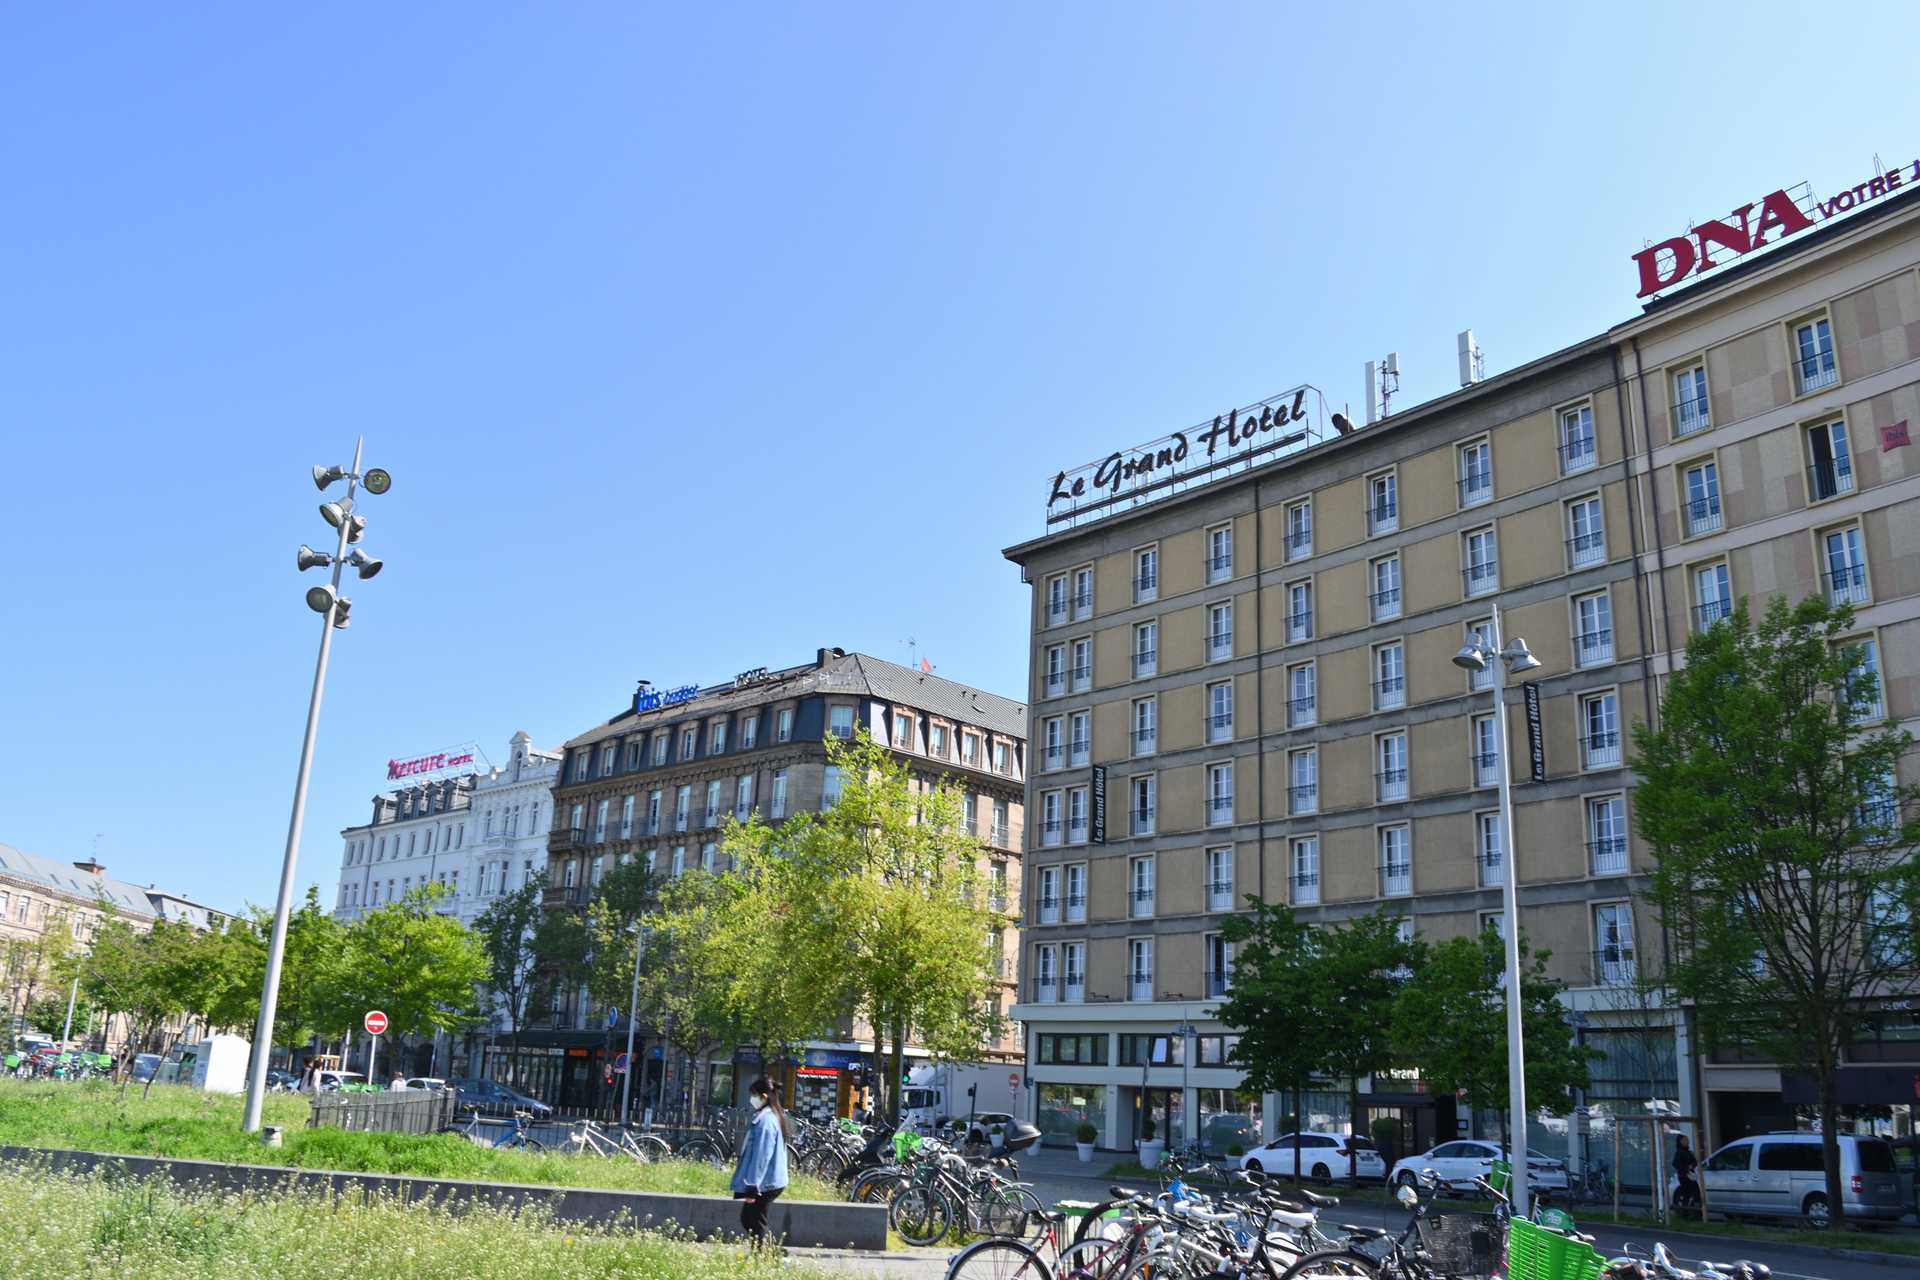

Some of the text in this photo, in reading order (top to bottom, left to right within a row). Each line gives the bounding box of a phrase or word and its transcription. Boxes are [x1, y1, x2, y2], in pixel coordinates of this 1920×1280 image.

[1631, 188, 1815, 299] DNA
[1817, 168, 1904, 220] VOTRE
[1047, 389, 1307, 508] Le Grand Hotel
[664, 684, 699, 704] budget
[1531, 722, 1542, 762] Grand
[387, 753, 447, 780] Mercure
[1535, 763, 1544, 780] Le
[1095, 797, 1105, 828] Grand
[1094, 829, 1104, 842] Le
[1390, 1067, 1420, 1080] Grand
